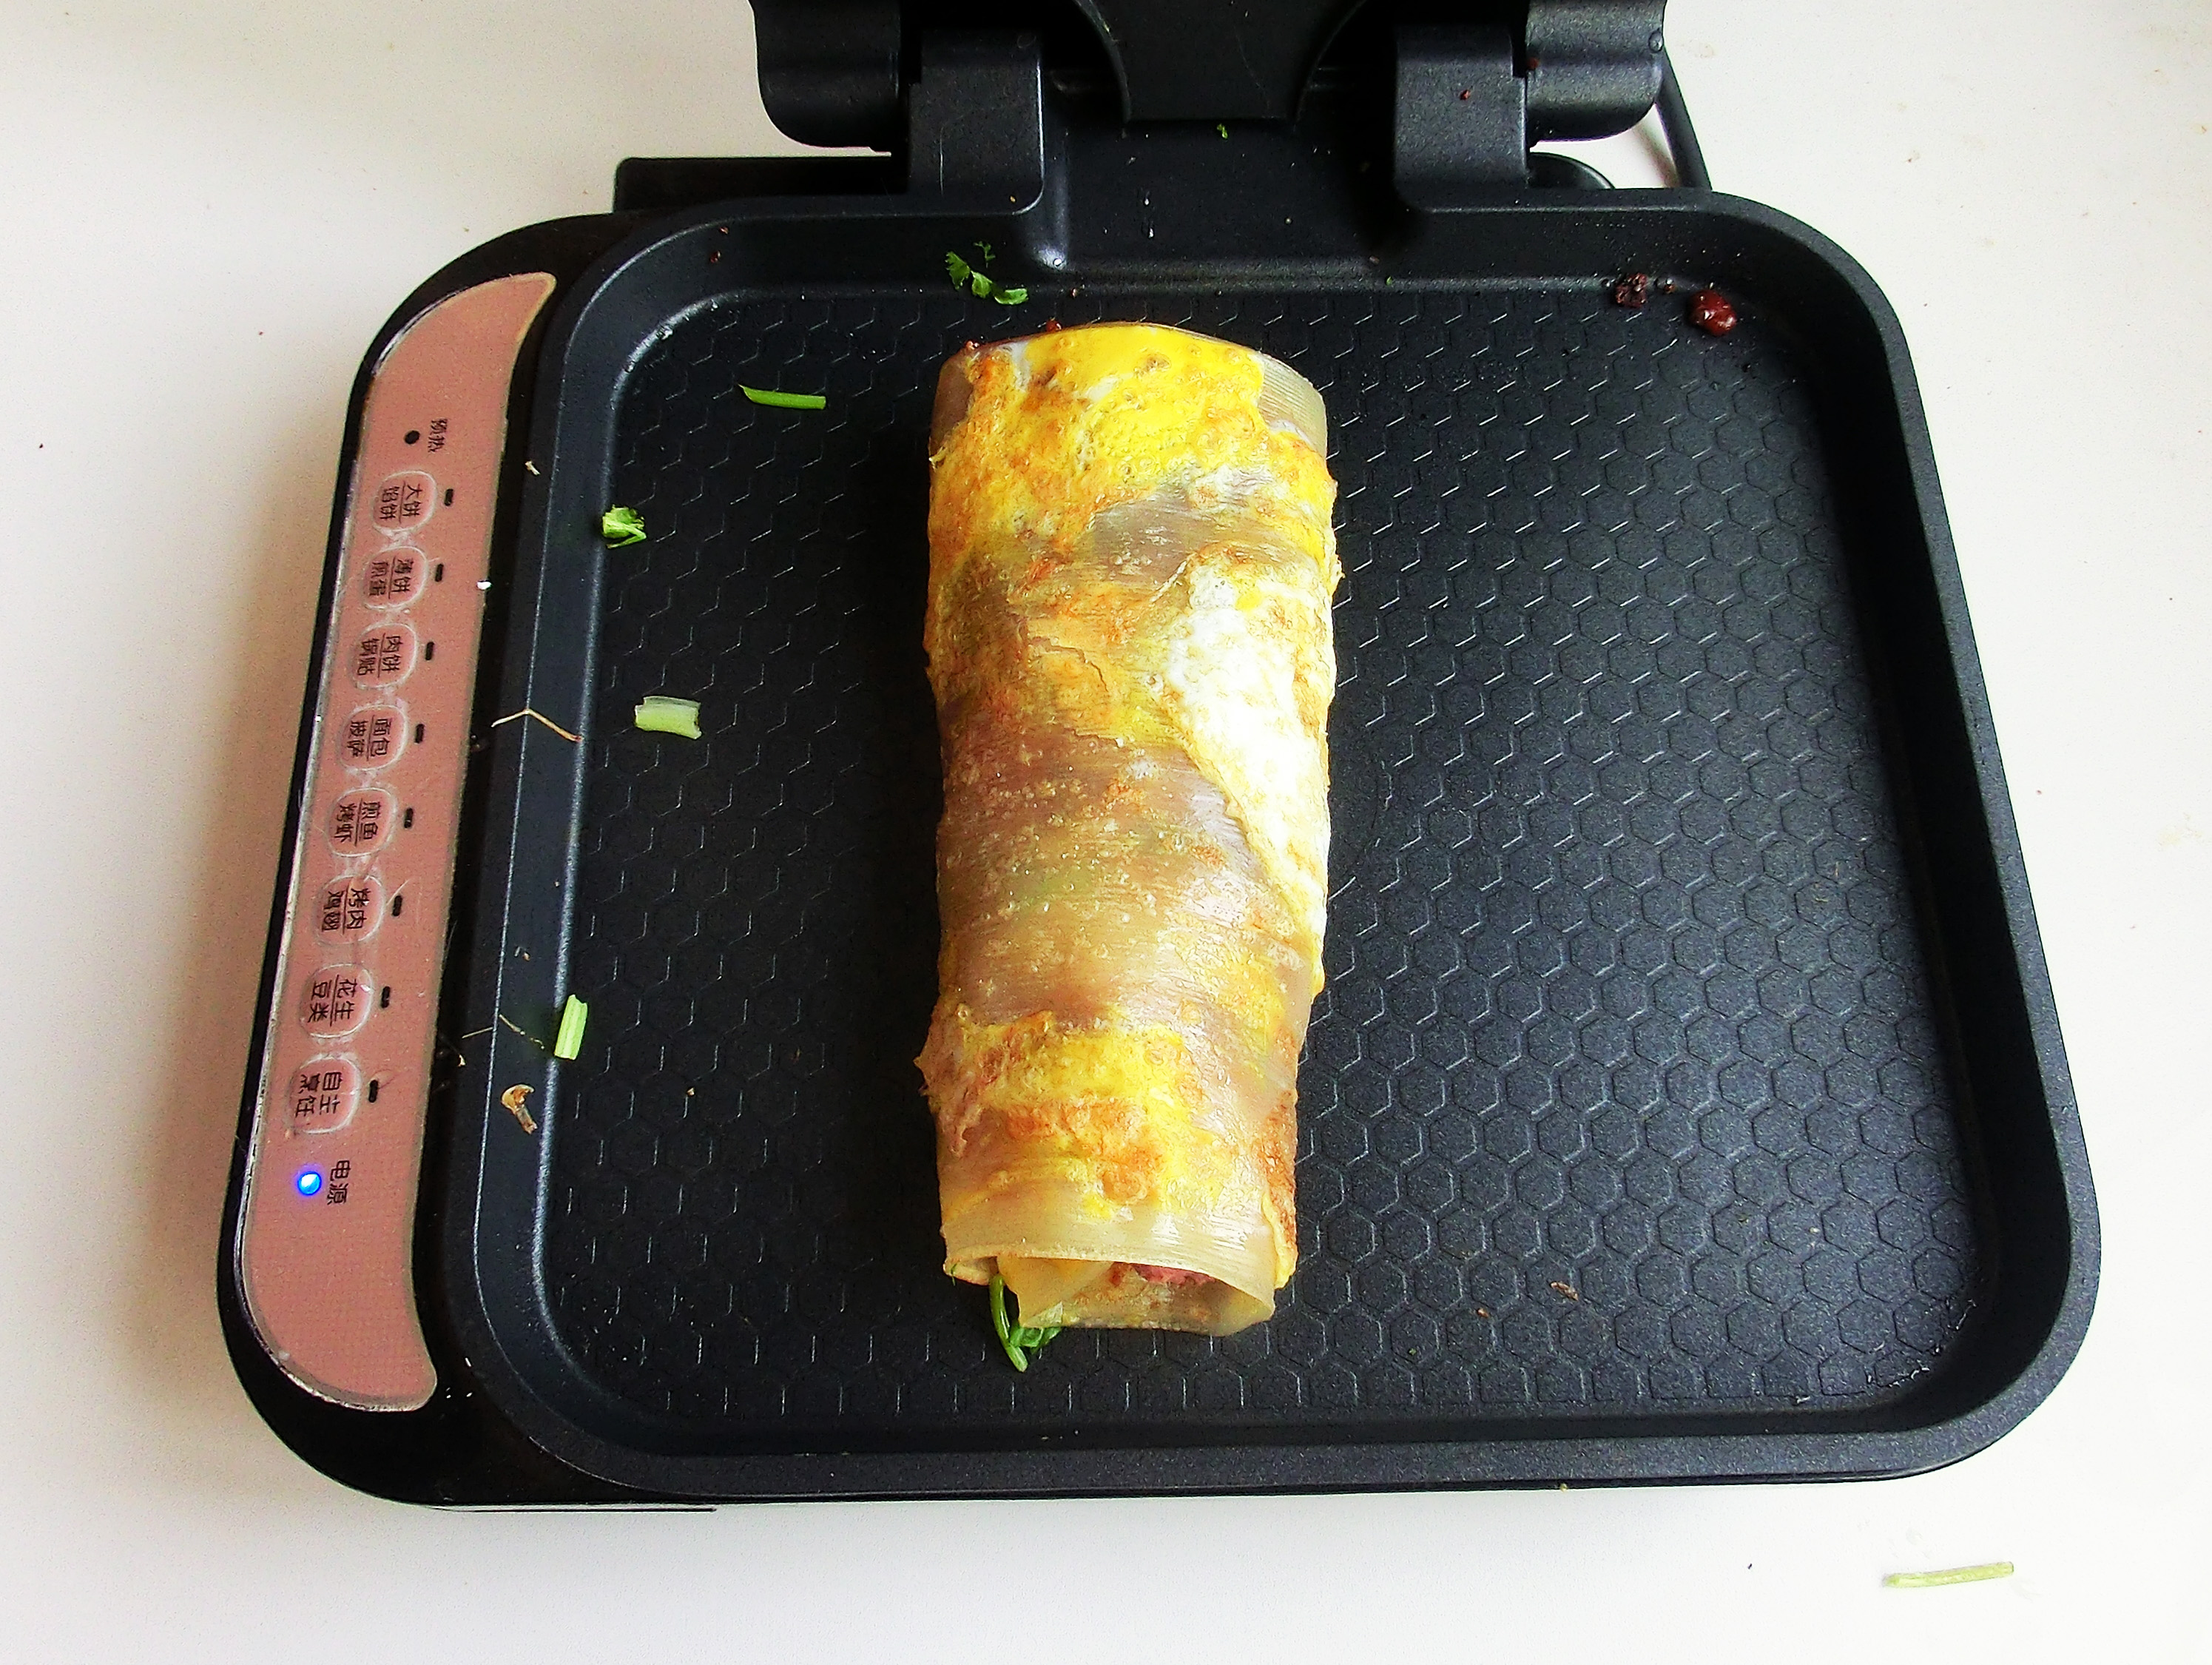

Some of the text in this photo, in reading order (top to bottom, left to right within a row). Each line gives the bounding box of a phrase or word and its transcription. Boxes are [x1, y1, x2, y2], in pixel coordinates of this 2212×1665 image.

[427, 417, 448, 453] 预热
[378, 485, 399, 520] 馅饼
[402, 483, 422, 517] 大饼
[368, 560, 388, 597] 煎蛋
[391, 557, 413, 593] 薄饼
[357, 637, 378, 676] 锅贴
[380, 635, 402, 673] 肉饼
[370, 718, 391, 757] 面包
[333, 803, 356, 843] 烤虾
[358, 801, 380, 841] 煎鱼
[321, 890, 343, 932] 鸡翅
[345, 887, 370, 929] 烤肉
[307, 979, 330, 1023] 豆类
[333, 978, 357, 1022] 花生
[294, 1072, 320, 1118] 烹饪
[319, 1071, 342, 1115] 自主
[326, 1160, 351, 1205] 电源
